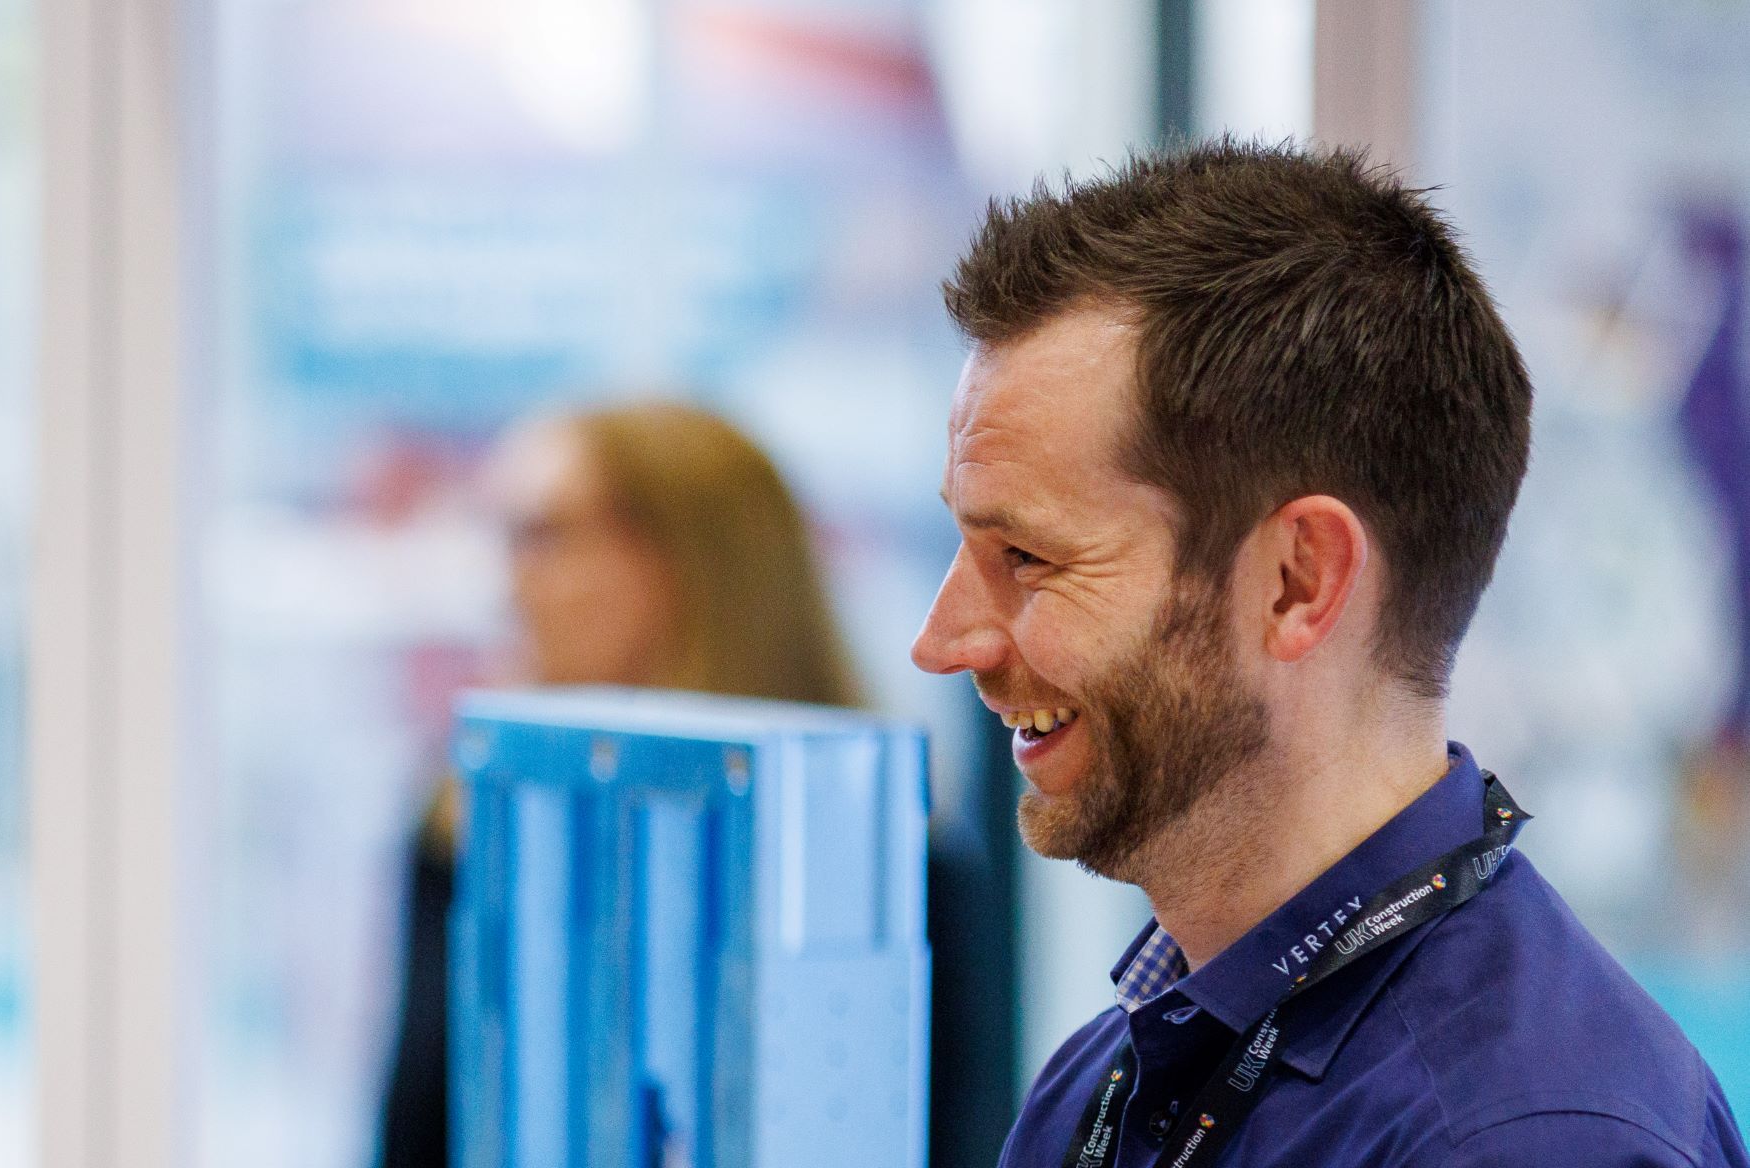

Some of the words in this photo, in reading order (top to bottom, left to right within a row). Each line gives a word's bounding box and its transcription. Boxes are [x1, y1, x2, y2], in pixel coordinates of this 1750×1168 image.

[1335, 921, 1374, 955] UK
[1365, 884, 1434, 927] Construction
[1370, 914, 1405, 936] Week
[1228, 1053, 1266, 1092] UK
[1248, 1009, 1277, 1055] Constru
[1257, 1027, 1279, 1060] Week
[1083, 1083, 1116, 1155] Construction
[1093, 1125, 1113, 1158] Week
